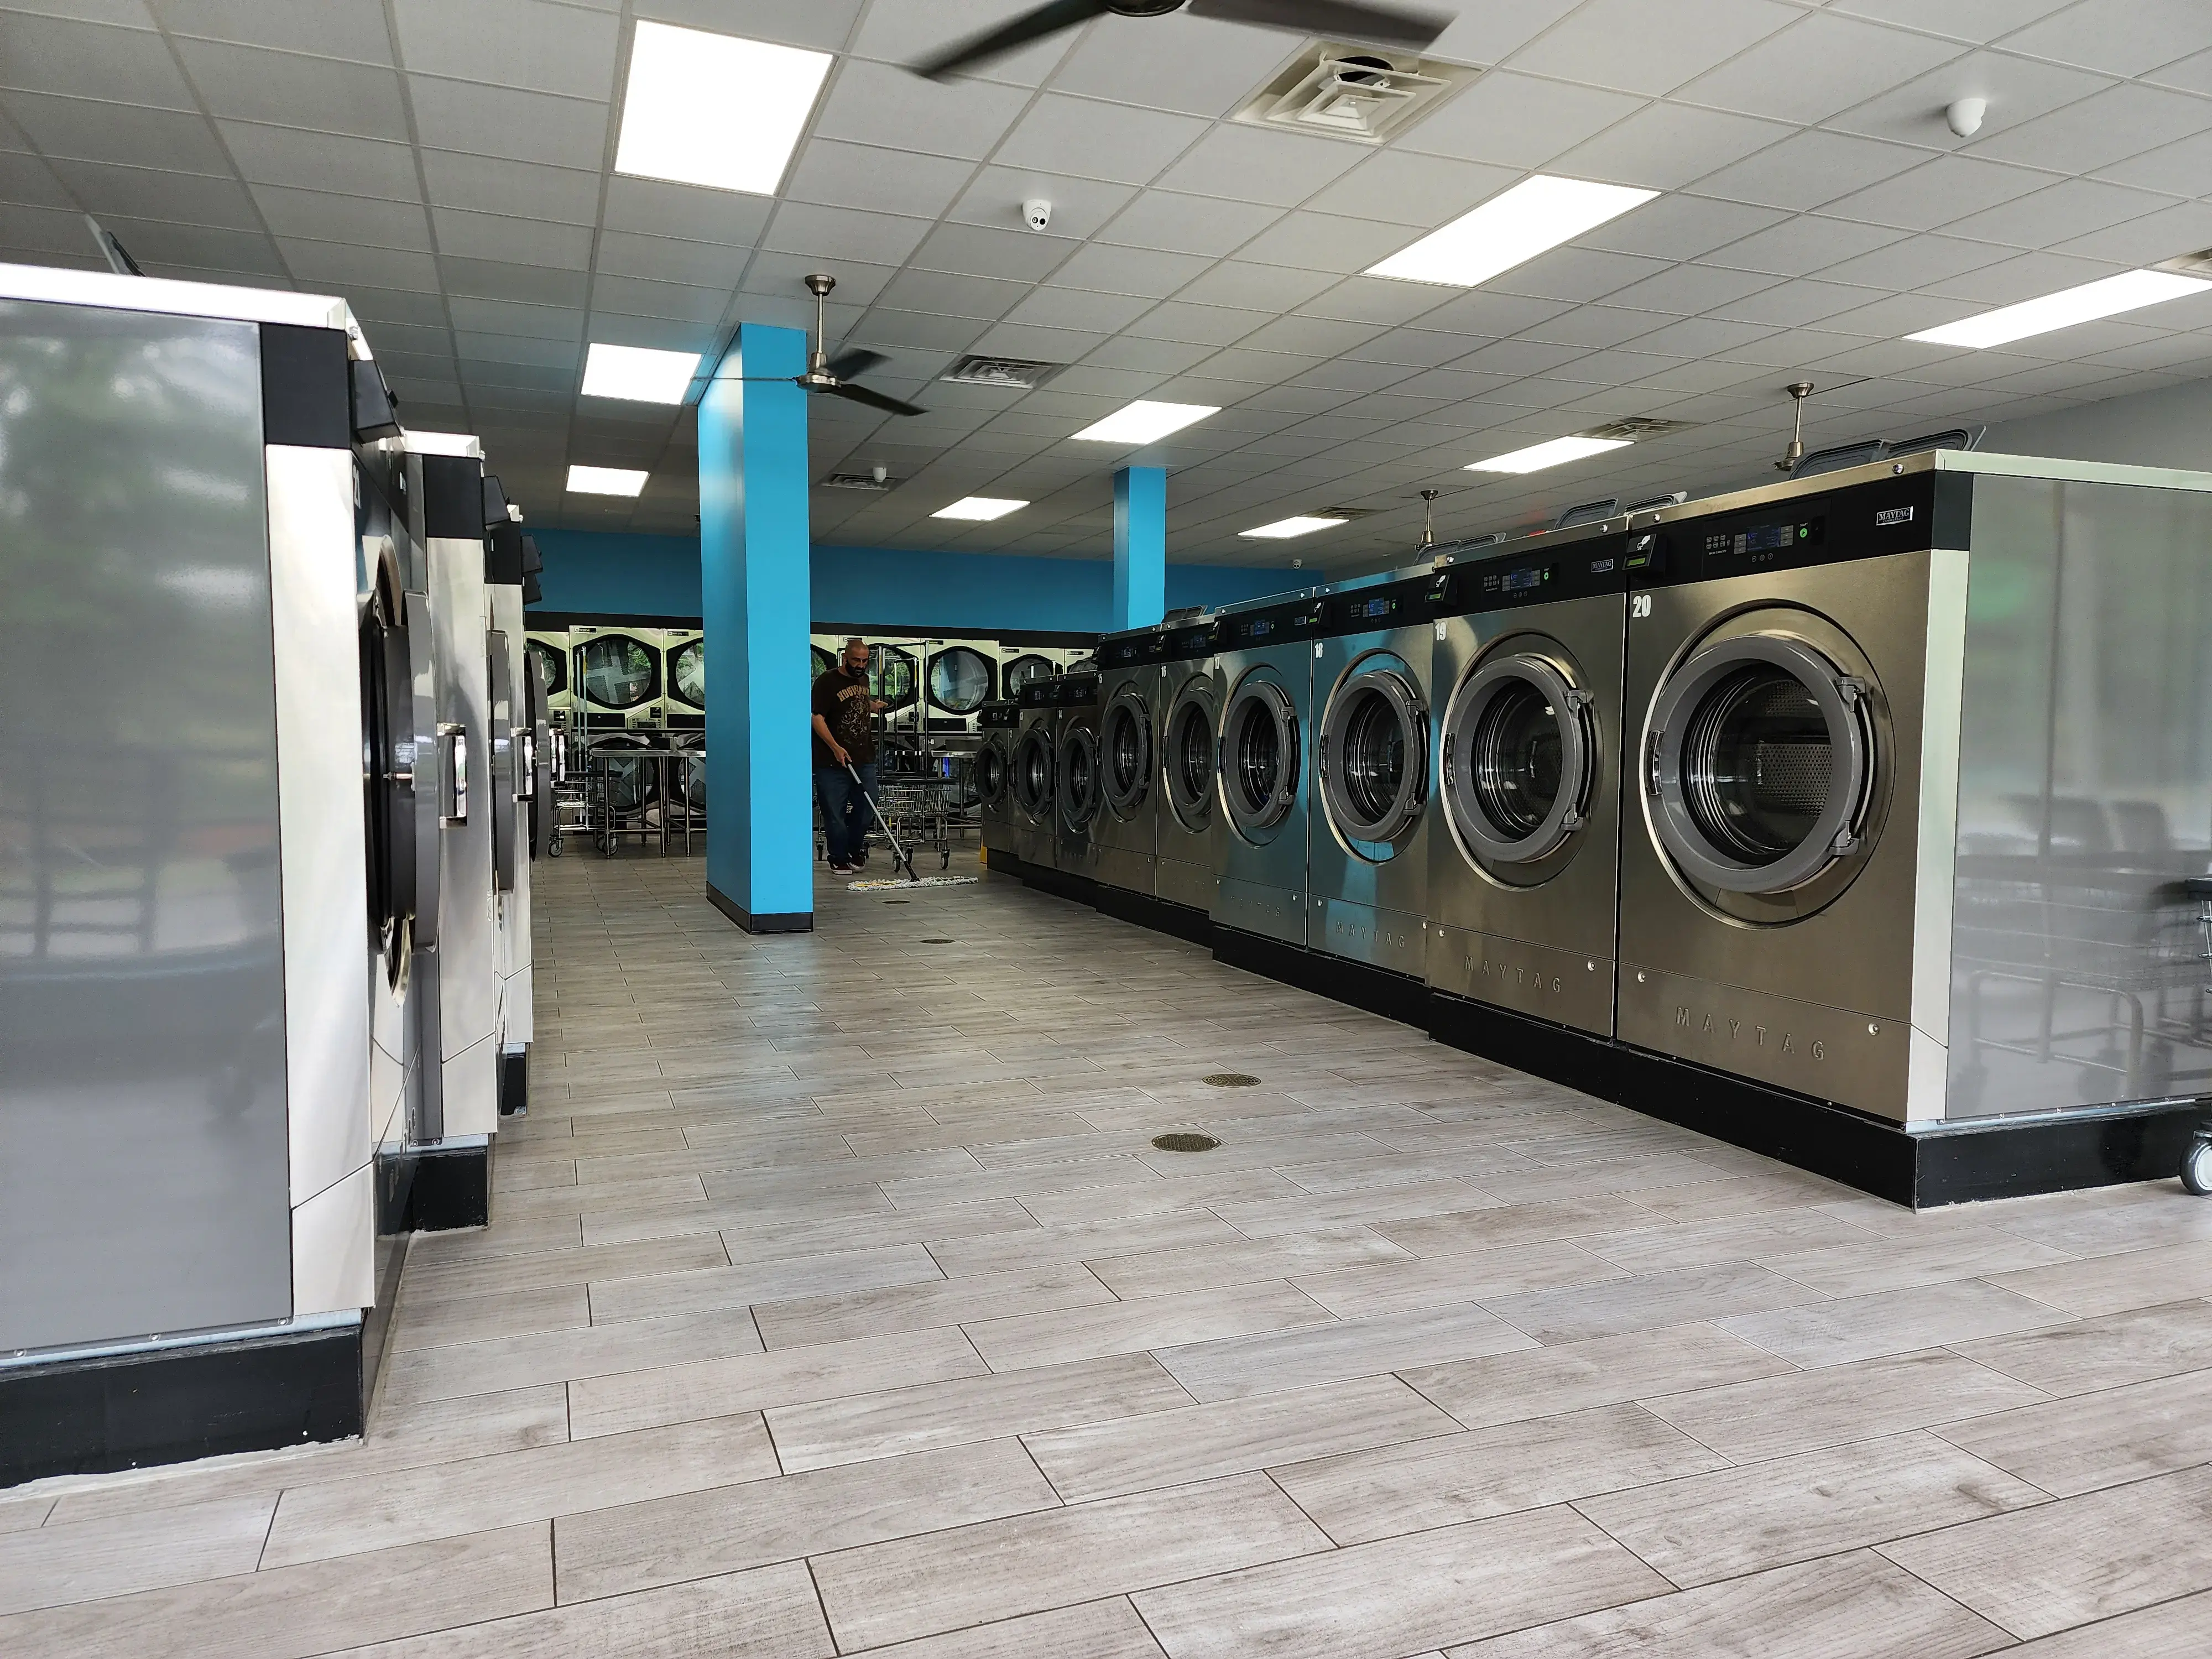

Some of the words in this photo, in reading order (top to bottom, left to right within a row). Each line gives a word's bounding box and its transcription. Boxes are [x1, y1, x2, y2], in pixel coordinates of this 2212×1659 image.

[1879, 509, 1910, 521] MAYTAG
[1593, 560, 1611, 569] MAYTAG
[1632, 594, 1651, 618] 20
[1435, 622, 1447, 641] 19
[1314, 642, 1323, 658] 18
[1161, 665, 1166, 677] 16
[1214, 656, 1220, 670] 17
[1335, 920, 1405, 948] MAYTAG
[1464, 956, 1561, 993] MAYTAG
[1676, 1006, 1825, 1061] MAYTAG
